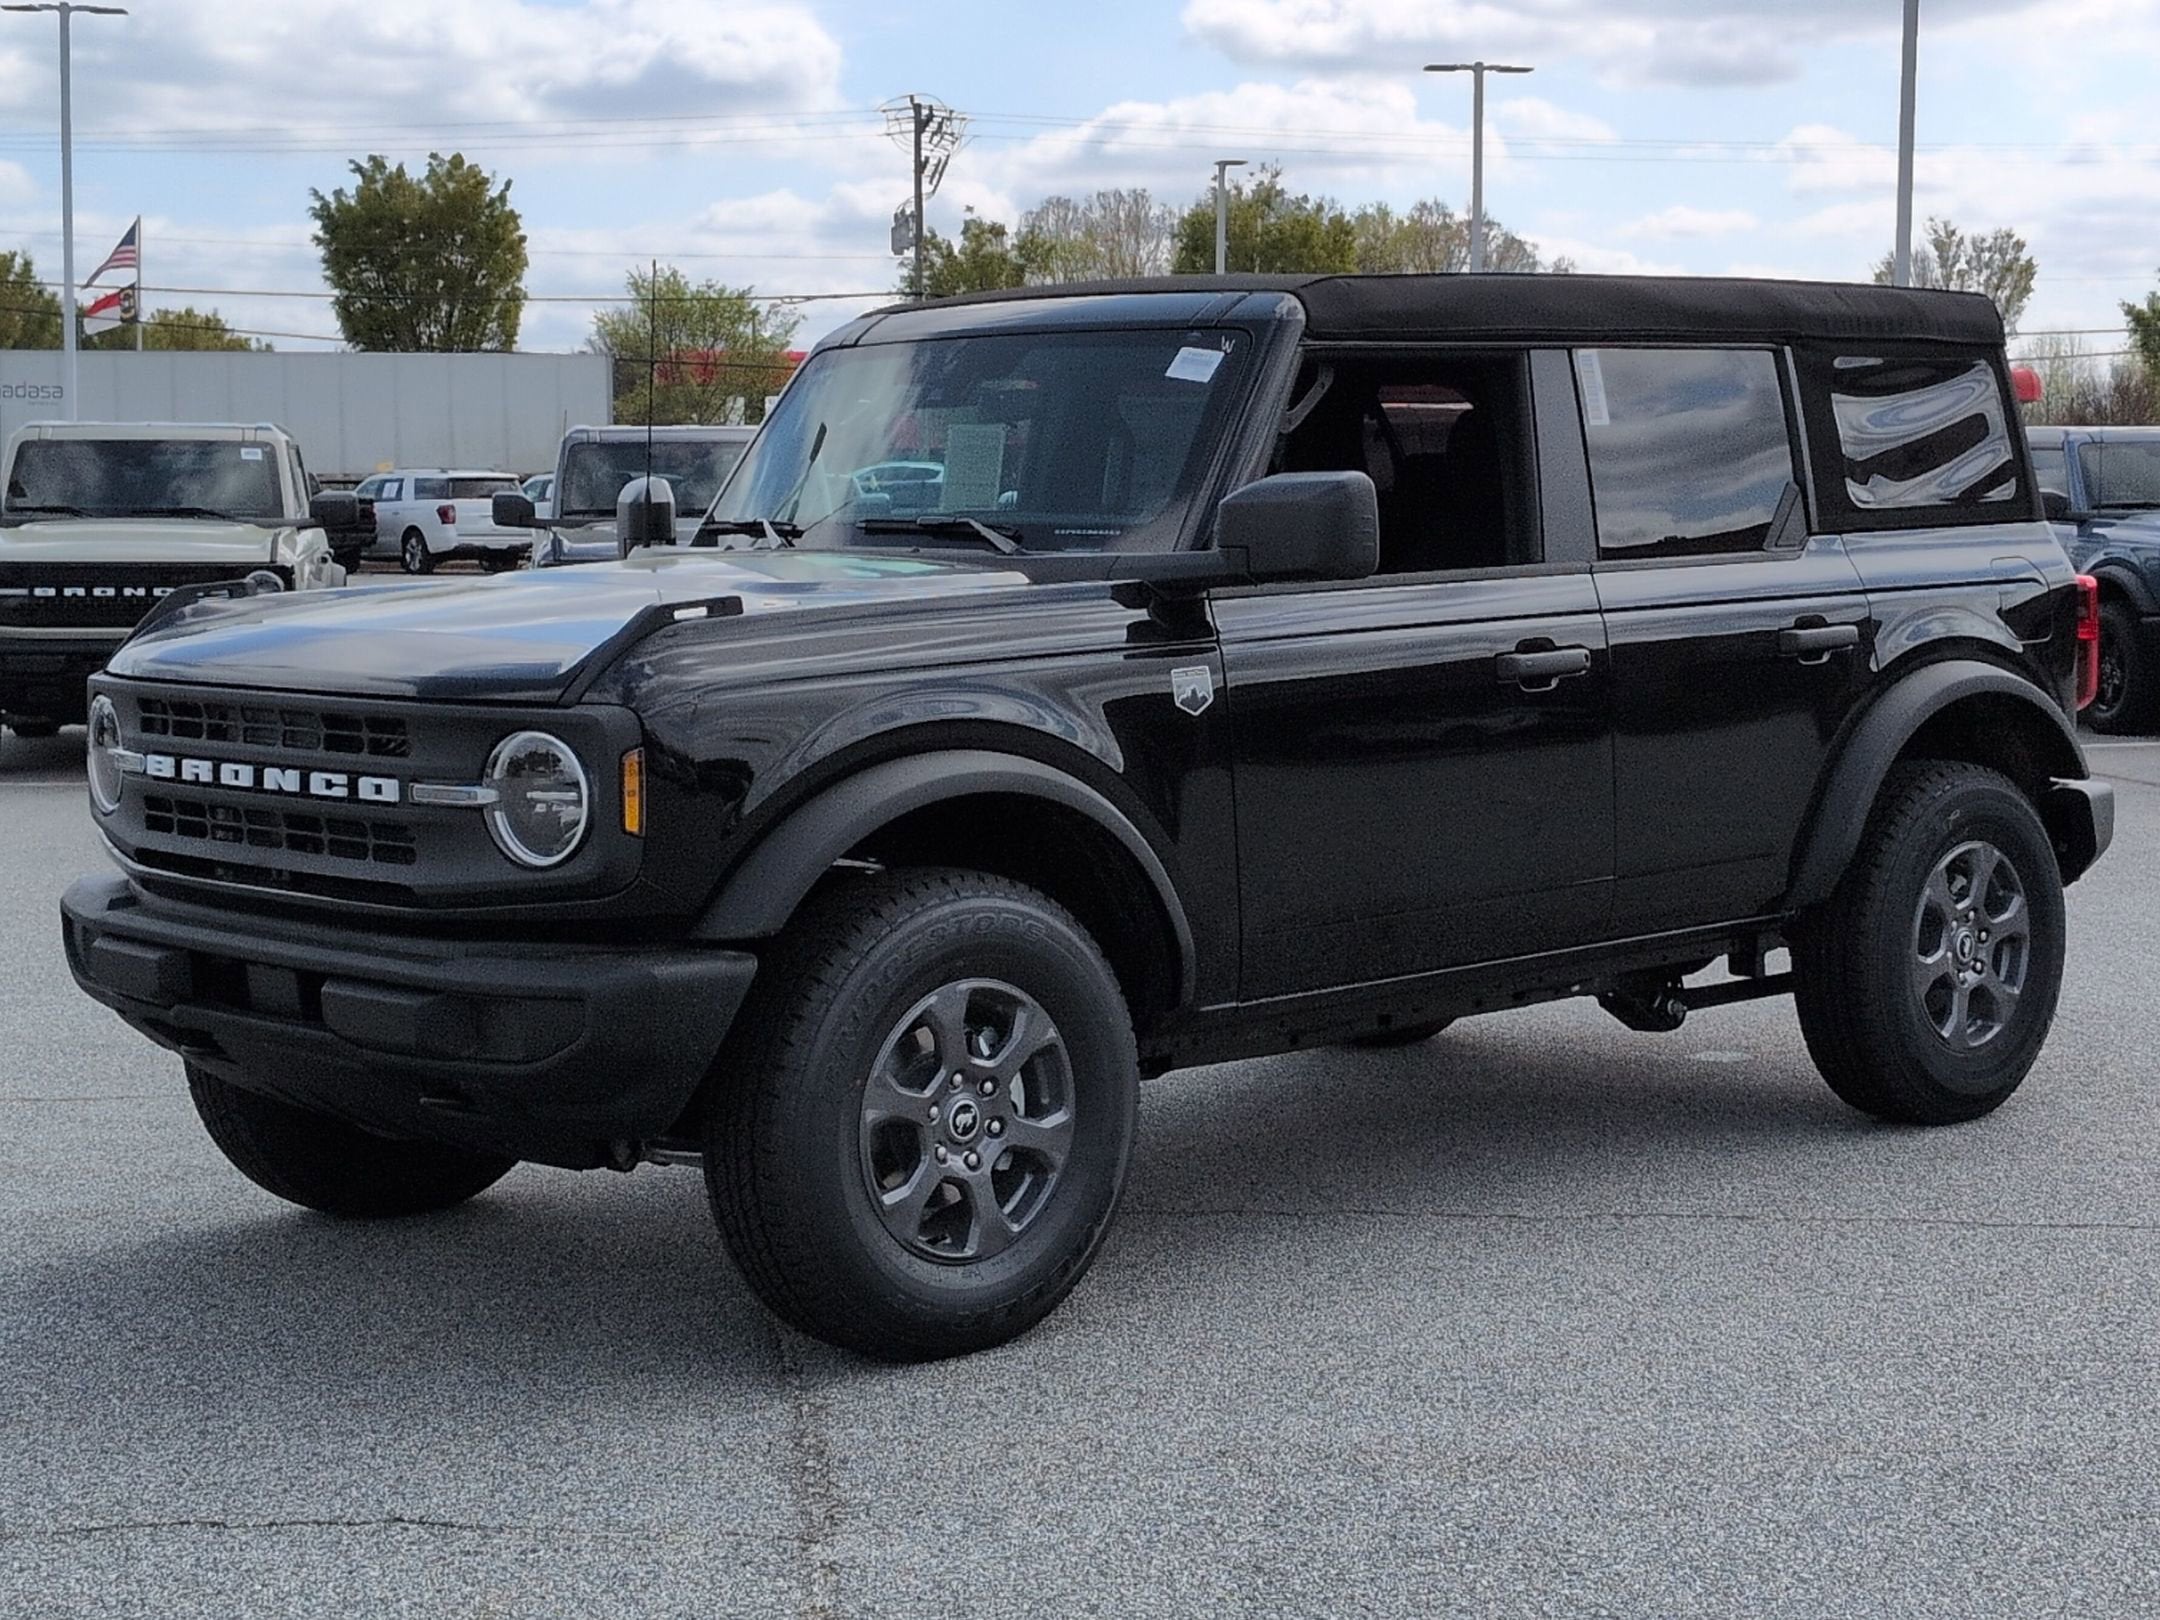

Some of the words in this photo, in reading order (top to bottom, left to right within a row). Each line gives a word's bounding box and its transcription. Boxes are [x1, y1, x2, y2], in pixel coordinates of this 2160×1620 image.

[0, 380, 64, 399] adasa
[33, 587, 174, 597] BRONC
[146, 754, 399, 802] BRONCO
